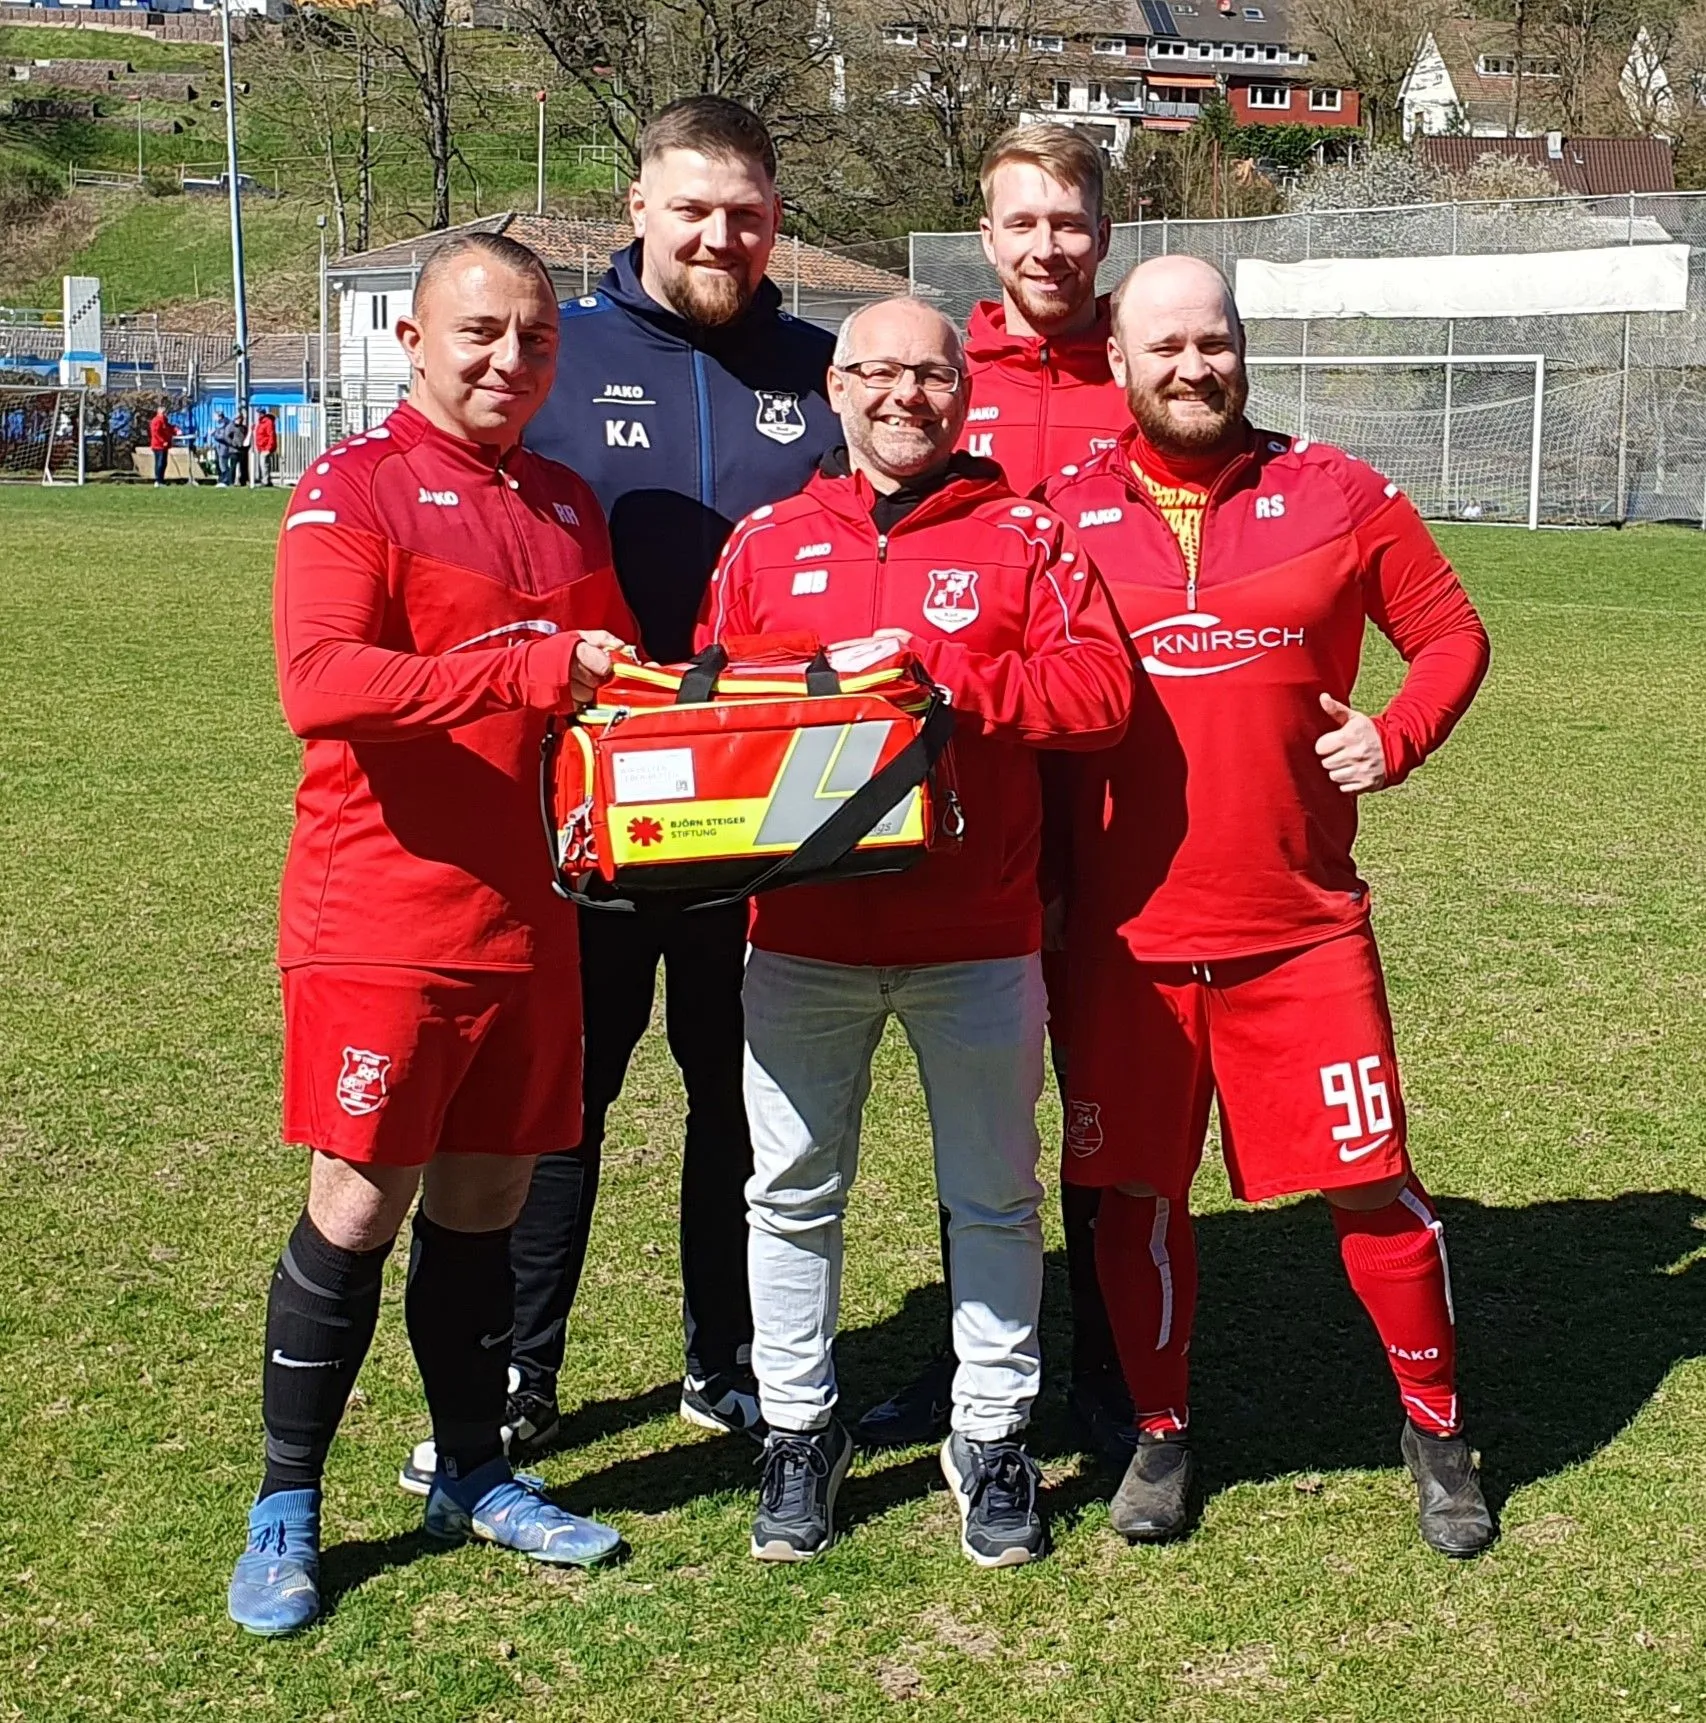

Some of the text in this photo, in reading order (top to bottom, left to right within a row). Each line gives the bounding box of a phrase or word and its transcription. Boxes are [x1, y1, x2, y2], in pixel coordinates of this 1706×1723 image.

[603, 384, 644, 399] JAKO
[606, 419, 650, 448] KA
[969, 432, 994, 457] LK
[1078, 507, 1123, 528] JAKO
[1256, 494, 1286, 519] RS
[1152, 627, 1305, 656] KNIRSCH
[670, 817, 746, 828] BJÖRN STEIGER
[671, 828, 717, 839] STIFTUNG
[1320, 1055, 1393, 1141] 96
[1389, 1344, 1438, 1360] JAKO
